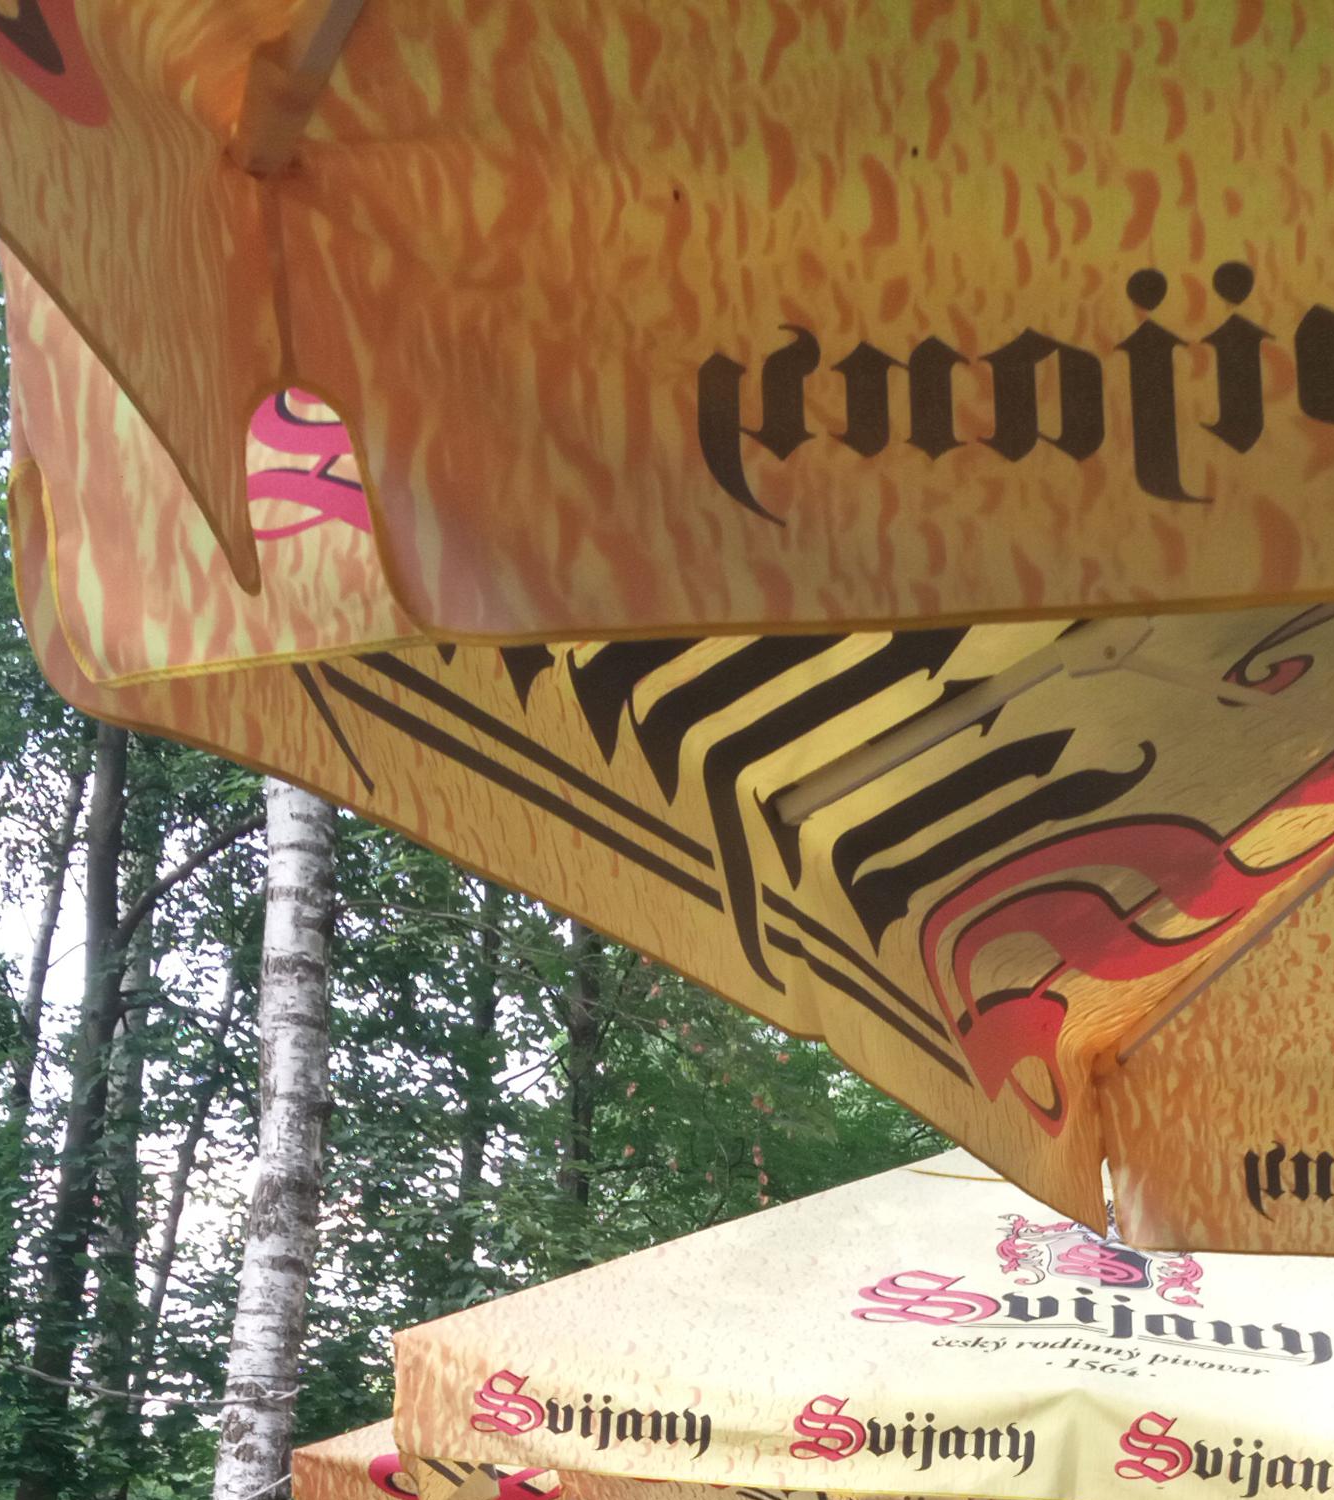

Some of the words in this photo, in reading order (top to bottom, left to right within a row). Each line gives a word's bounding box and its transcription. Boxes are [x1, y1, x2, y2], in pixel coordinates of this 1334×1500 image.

[850, 1269, 1334, 1366] Svijany
[931, 1335, 1007, 1353] český
[1015, 1336, 1143, 1362] rodinný
[1146, 1352, 1271, 1376] pivovar
[1065, 1357, 1141, 1378] 1564
[469, 1368, 712, 1461] Svijany
[789, 1393, 1036, 1478] Svijany
